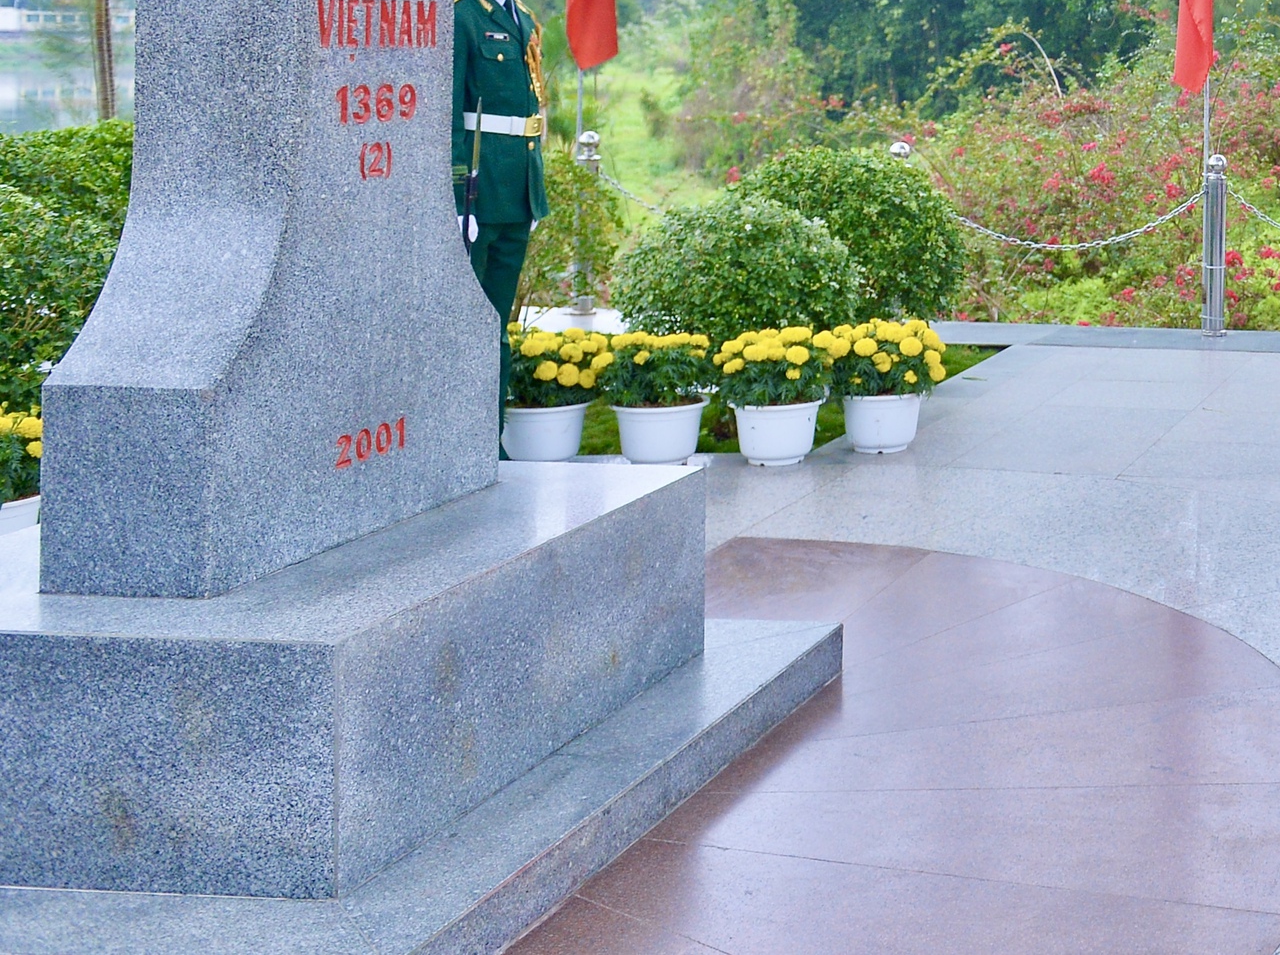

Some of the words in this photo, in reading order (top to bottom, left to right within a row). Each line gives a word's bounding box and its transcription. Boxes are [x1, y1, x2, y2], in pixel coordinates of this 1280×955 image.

[335, 83, 417, 126] 1369
[359, 141, 393, 181] (2)
[335, 415, 406, 469] 2001
